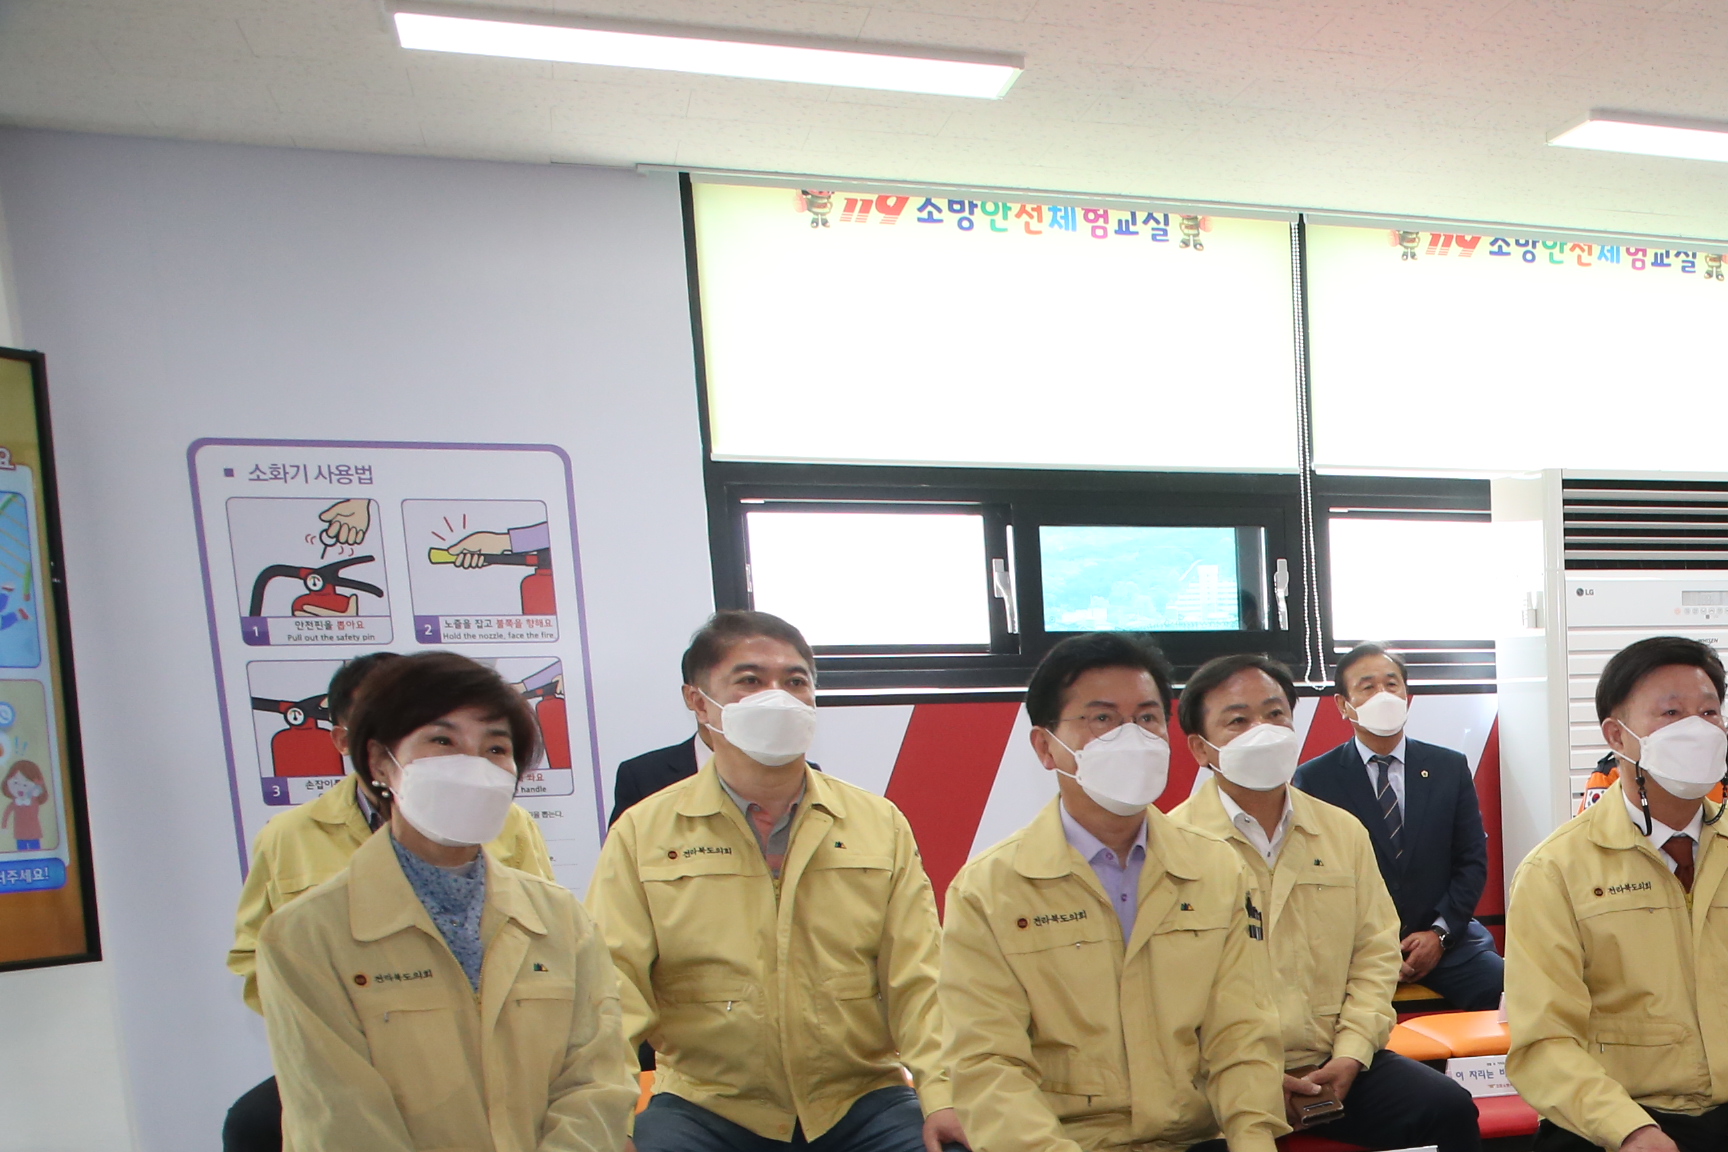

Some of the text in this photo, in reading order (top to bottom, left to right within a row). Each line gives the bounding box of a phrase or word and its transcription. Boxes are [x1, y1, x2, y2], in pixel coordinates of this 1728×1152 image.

[839, 195, 911, 225] 119
[248, 464, 373, 485] 소화기 사용법
[1586, 588, 1594, 596] LG
[295, 621, 365, 630] 안전핀을 뽑아요
[475, 619, 493, 628] 잡고
[253, 626, 258, 636] 1
[424, 625, 432, 635] 2
[336, 634, 360, 642] safety
[363, 634, 375, 642] pin
[272, 785, 280, 796] 3
[1456, 1072, 1464, 1080] 이
[1469, 1070, 1494, 1079] 자리는
